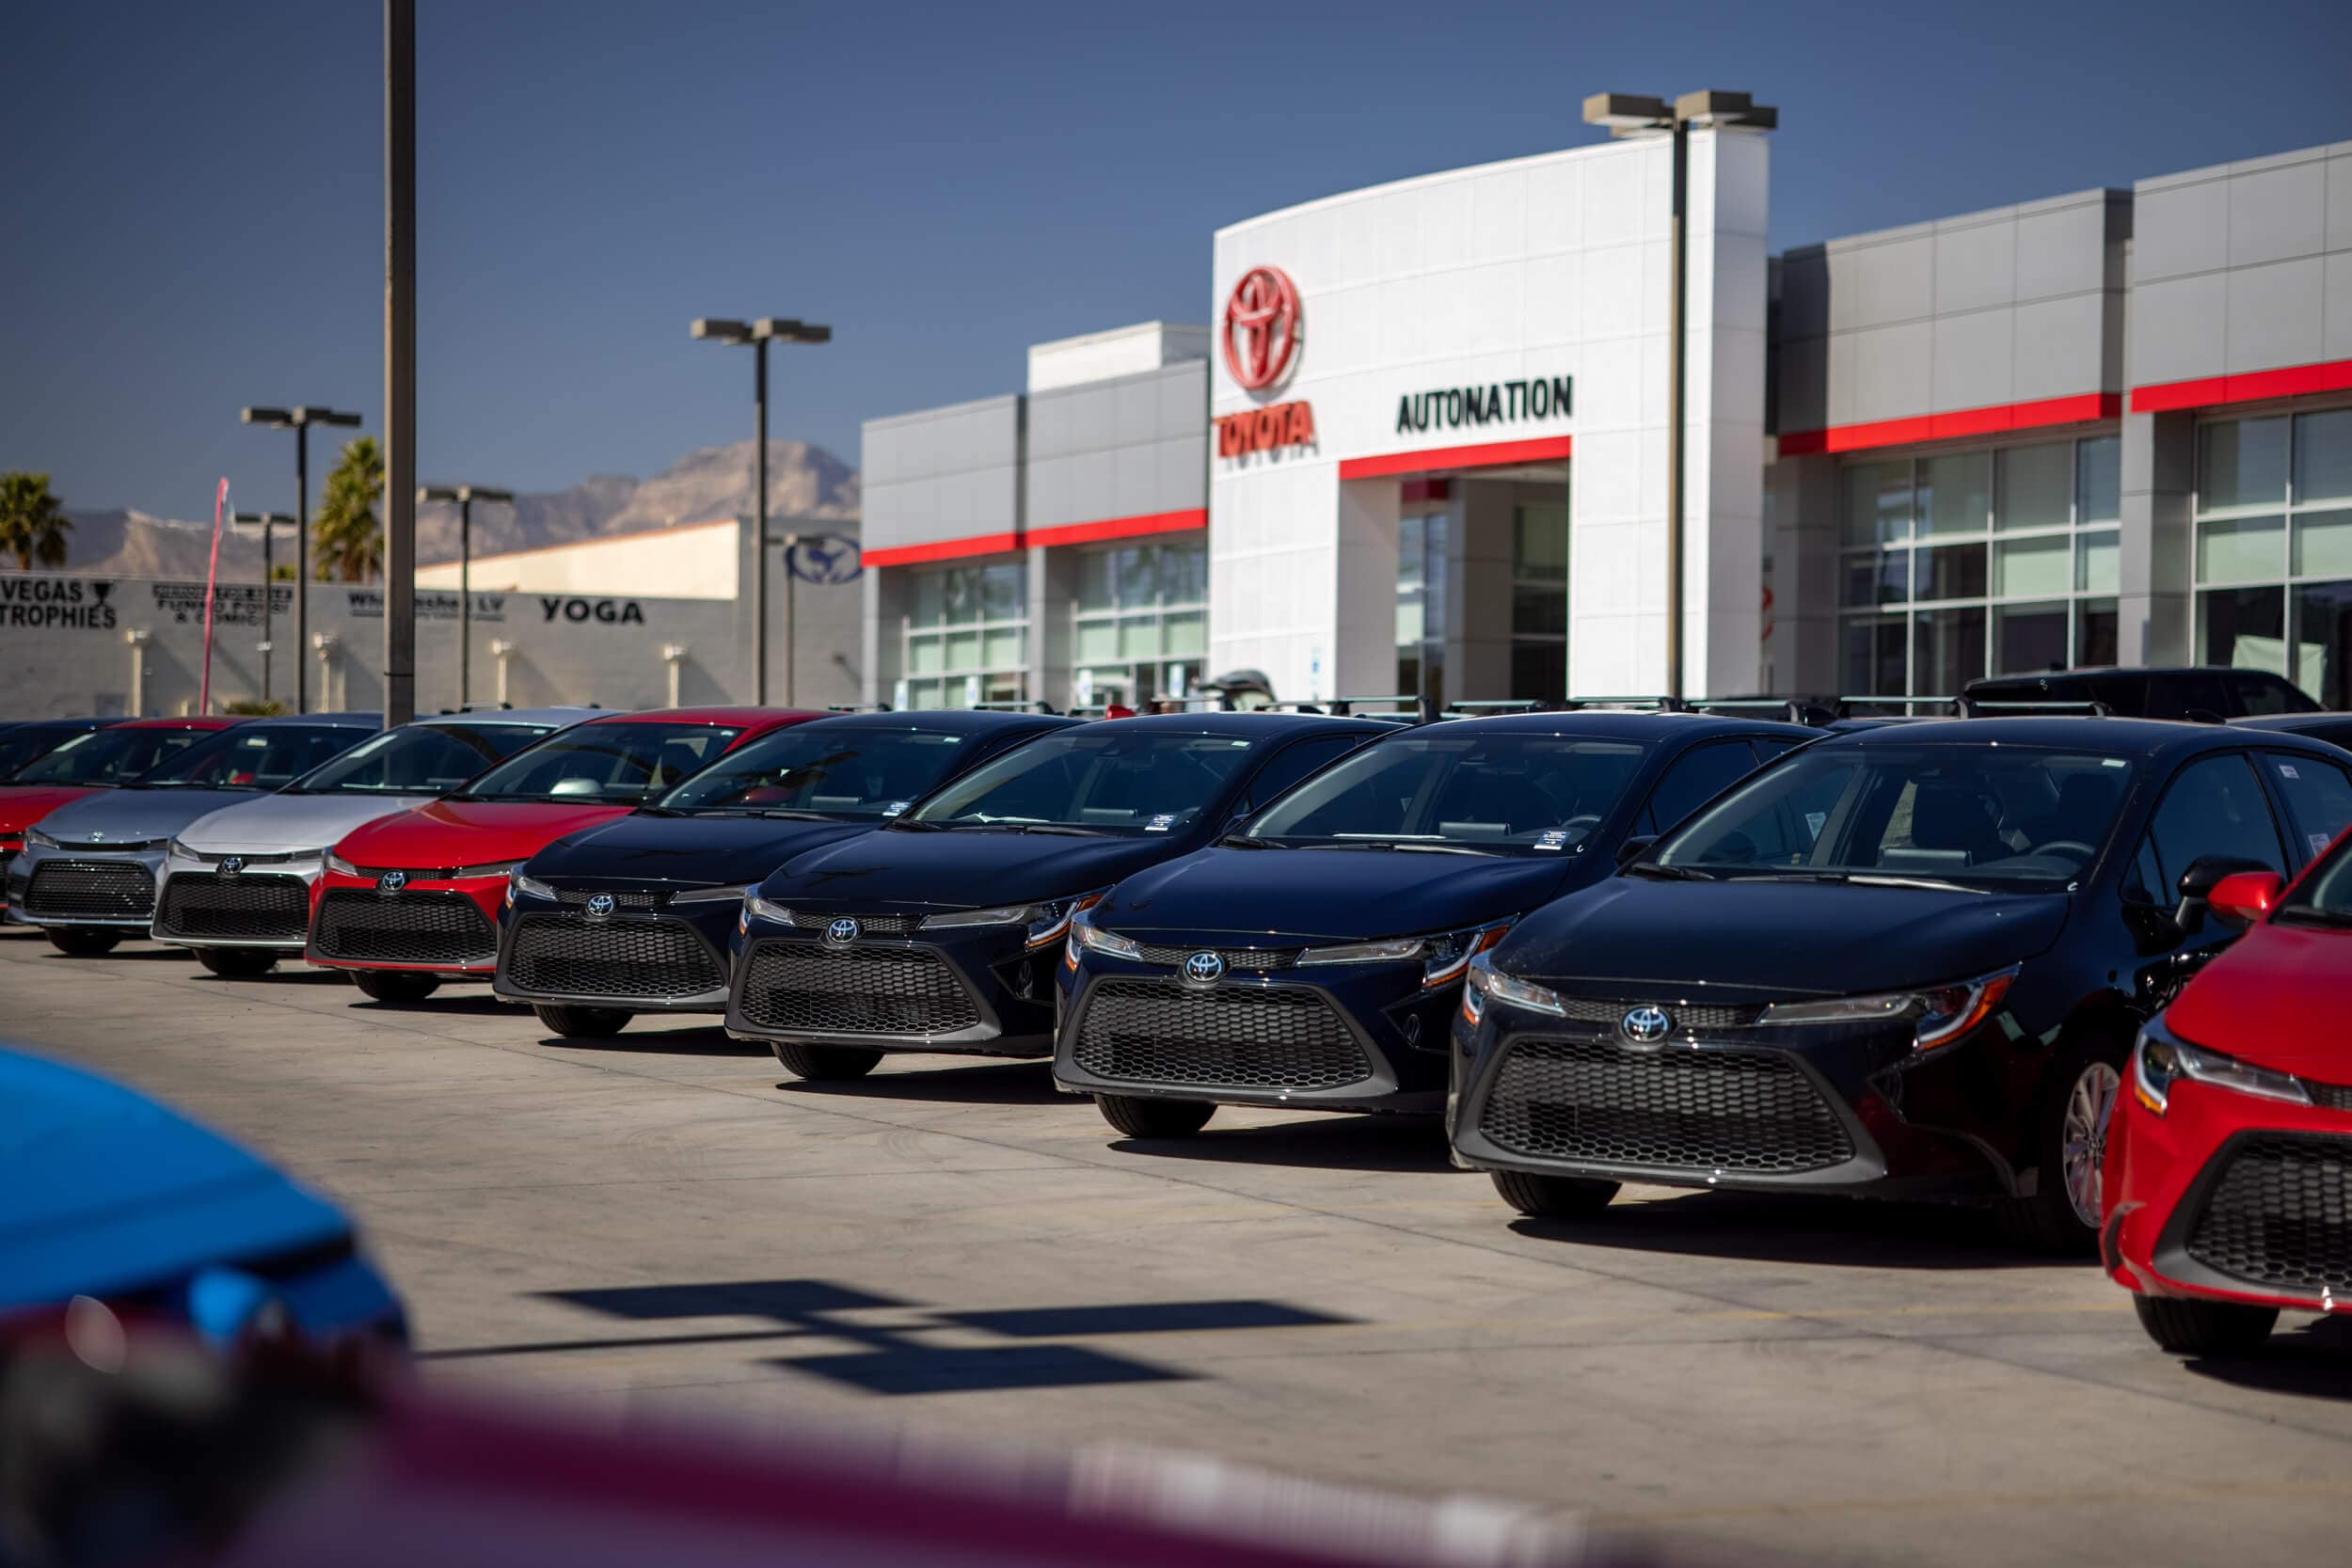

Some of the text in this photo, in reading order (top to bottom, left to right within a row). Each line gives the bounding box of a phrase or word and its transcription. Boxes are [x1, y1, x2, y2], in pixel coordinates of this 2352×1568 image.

[1396, 374, 1573, 434] AUTONATION
[1211, 400, 1314, 458] TOYOTA
[1, 579, 83, 603] VEGAS
[0, 603, 117, 629] TROPHIES
[540, 597, 645, 624] YOGA
